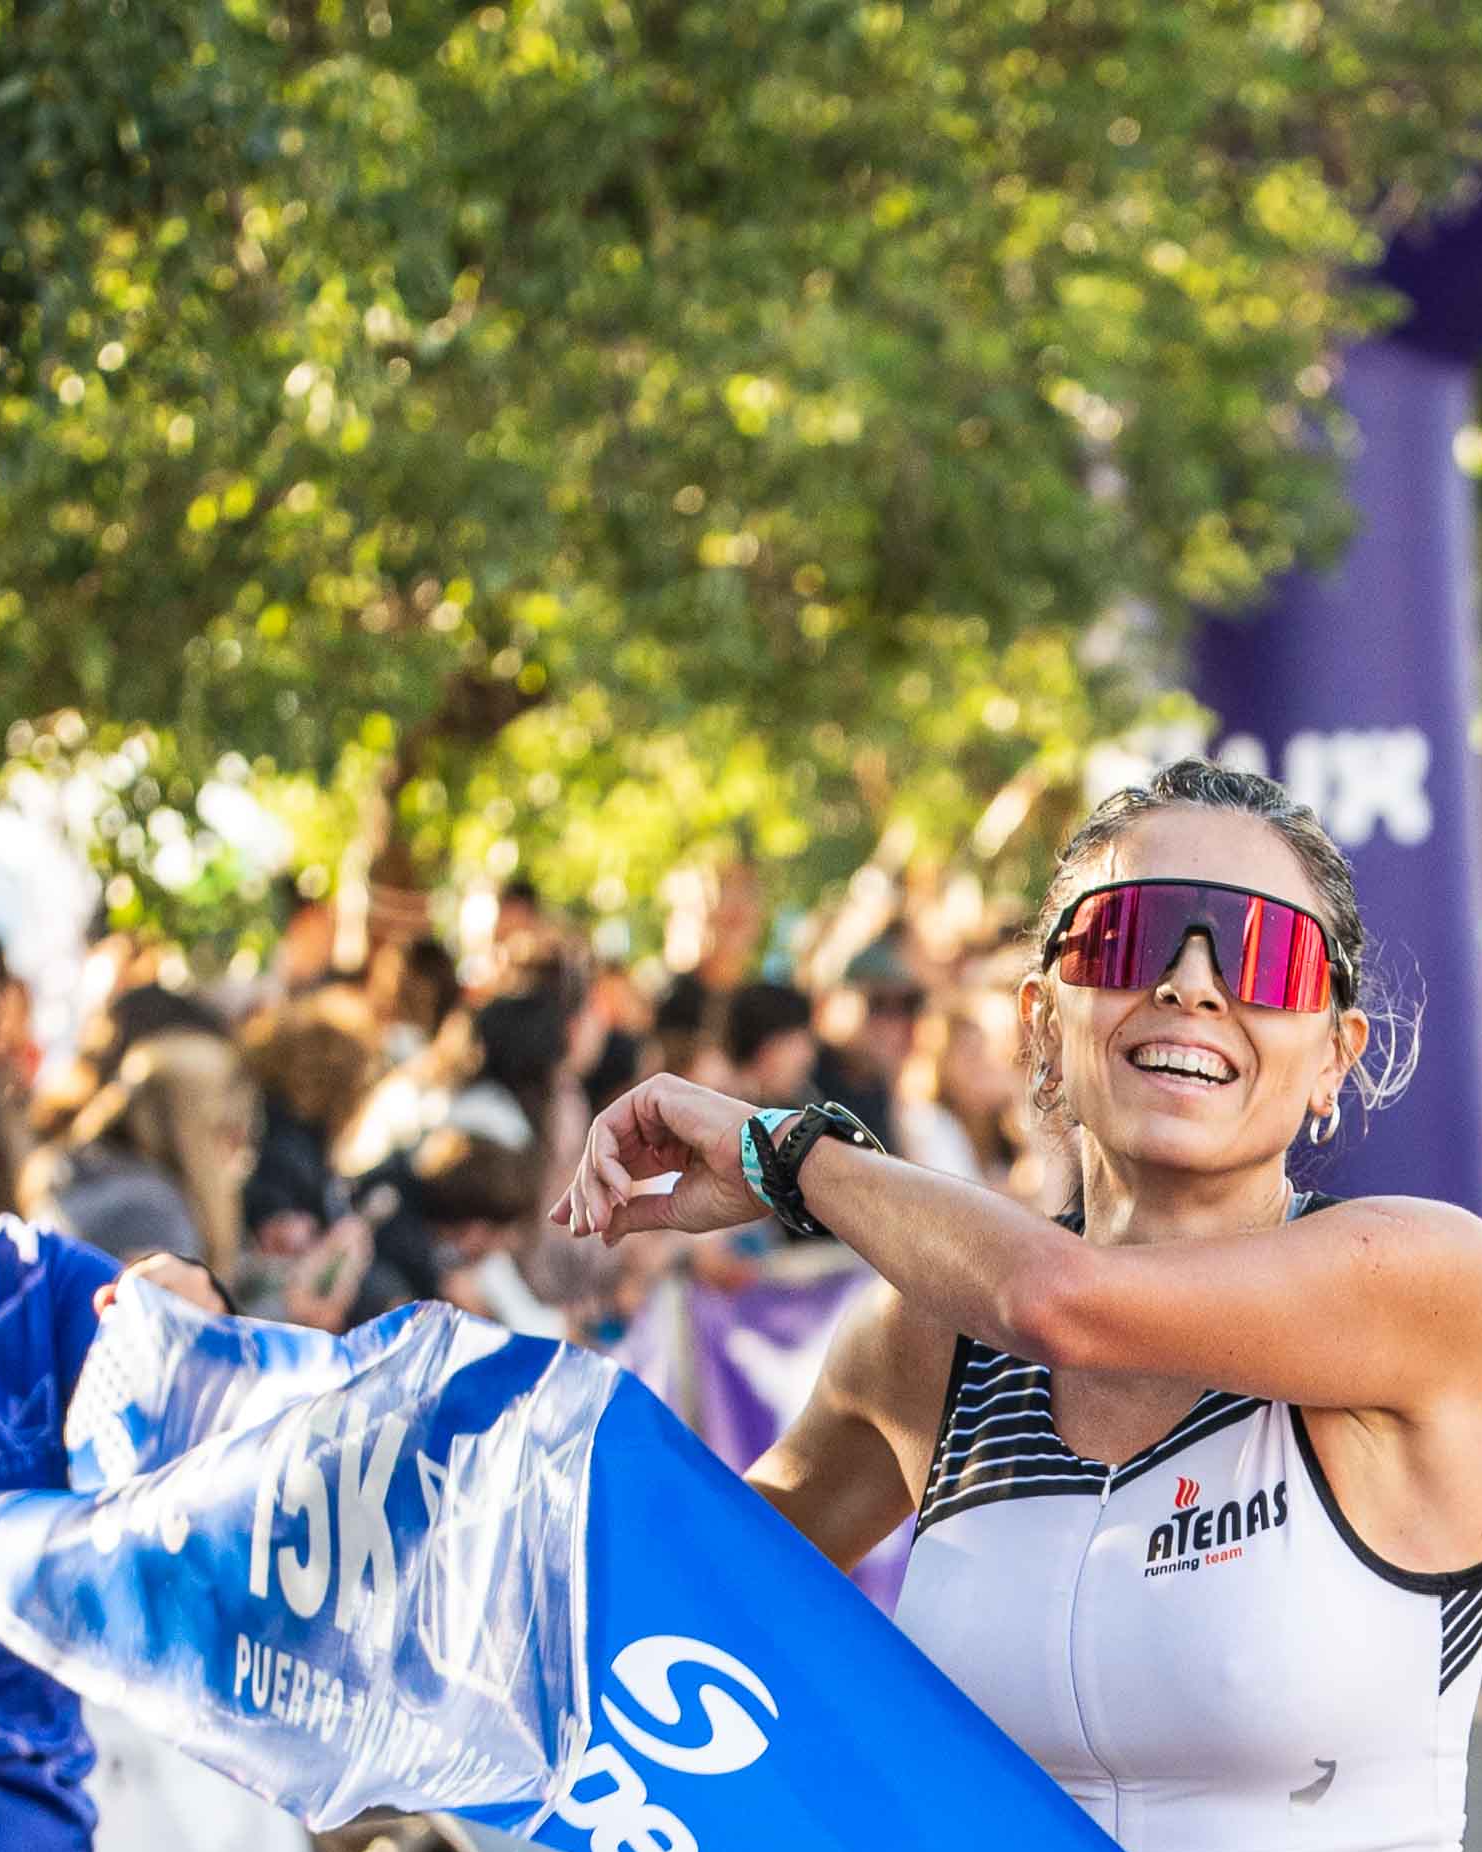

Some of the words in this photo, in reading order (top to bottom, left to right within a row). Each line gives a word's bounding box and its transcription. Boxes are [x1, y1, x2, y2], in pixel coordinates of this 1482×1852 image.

[1144, 1557, 1200, 1578] running
[1205, 1546, 1243, 1565] team
[1147, 1480, 1288, 1562] ATENAS
[234, 1632, 344, 1743] PUERTO
[343, 1688, 443, 1787] NORTE
